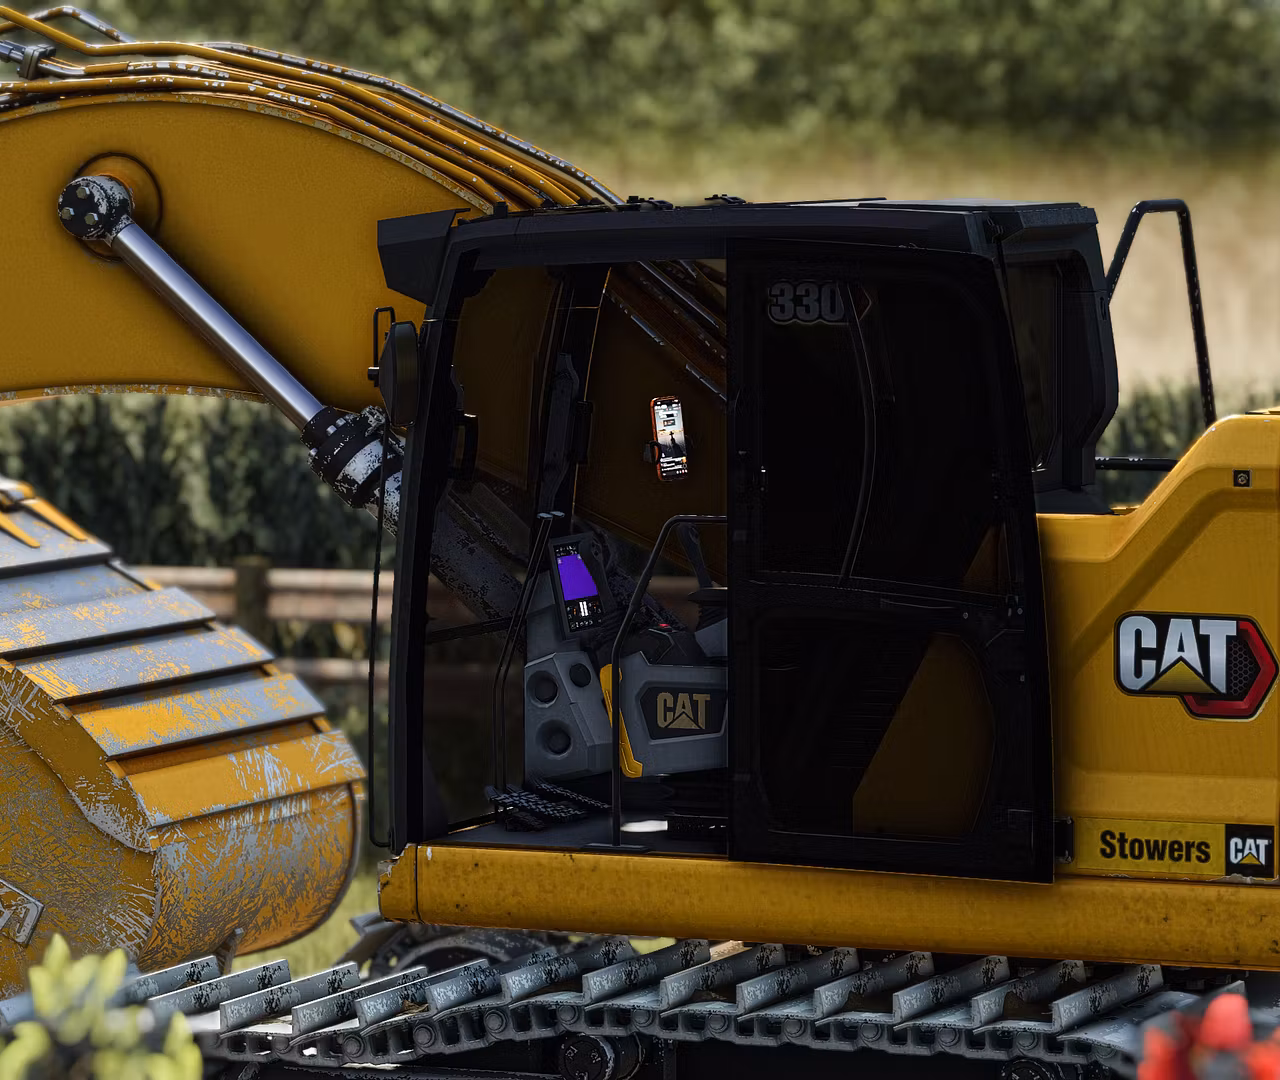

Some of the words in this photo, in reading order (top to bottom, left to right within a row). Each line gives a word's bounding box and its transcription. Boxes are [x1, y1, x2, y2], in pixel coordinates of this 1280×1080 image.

[771, 282, 844, 320] 330
[1120, 616, 1237, 693] CAT
[657, 692, 710, 729] CAT
[1100, 830, 1210, 863] Stowers
[1230, 838, 1268, 865] CAT
